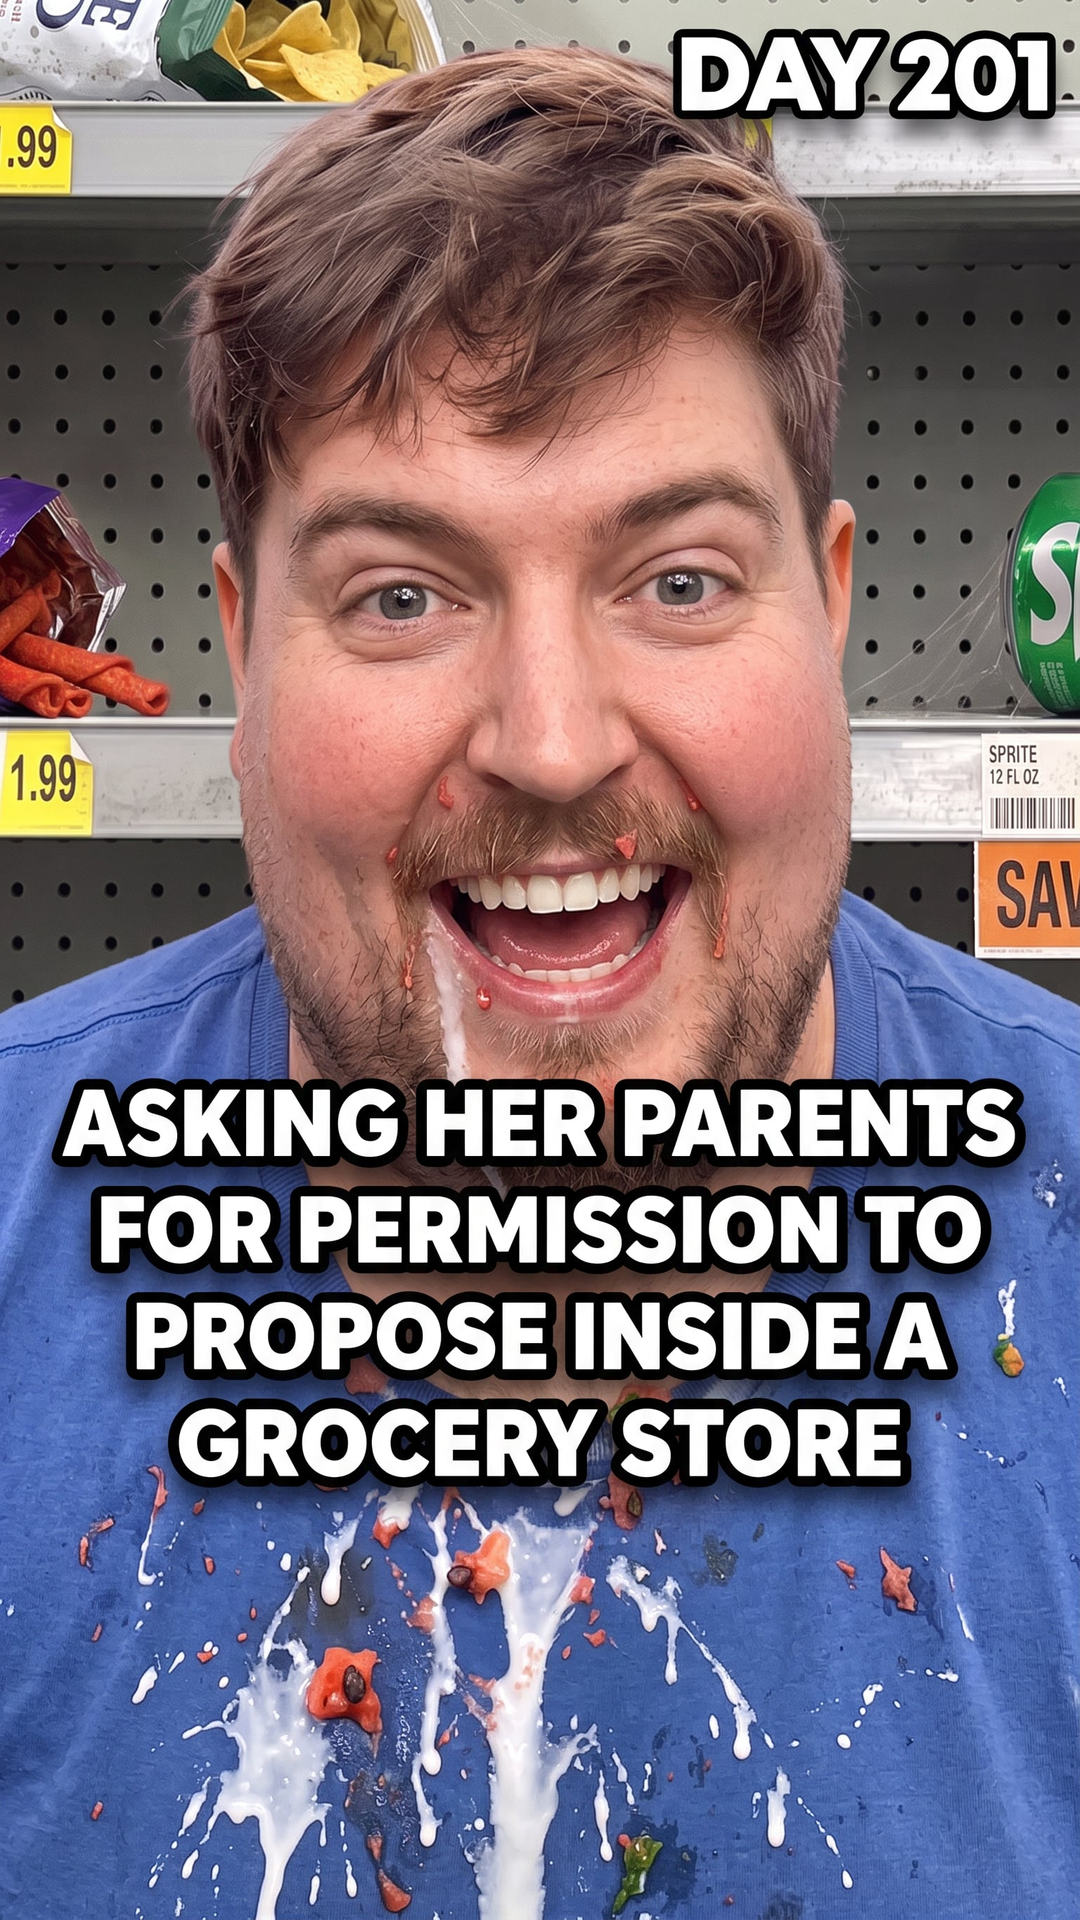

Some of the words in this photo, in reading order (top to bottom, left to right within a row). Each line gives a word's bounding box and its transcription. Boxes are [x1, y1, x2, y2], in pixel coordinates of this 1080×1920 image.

[989, 744, 1038, 764] SPRITE
[11, 753, 77, 802] 1.99
[990, 768, 1003, 785] 12
[1006, 768, 1020, 785] FL
[1023, 768, 1040, 785] OZ
